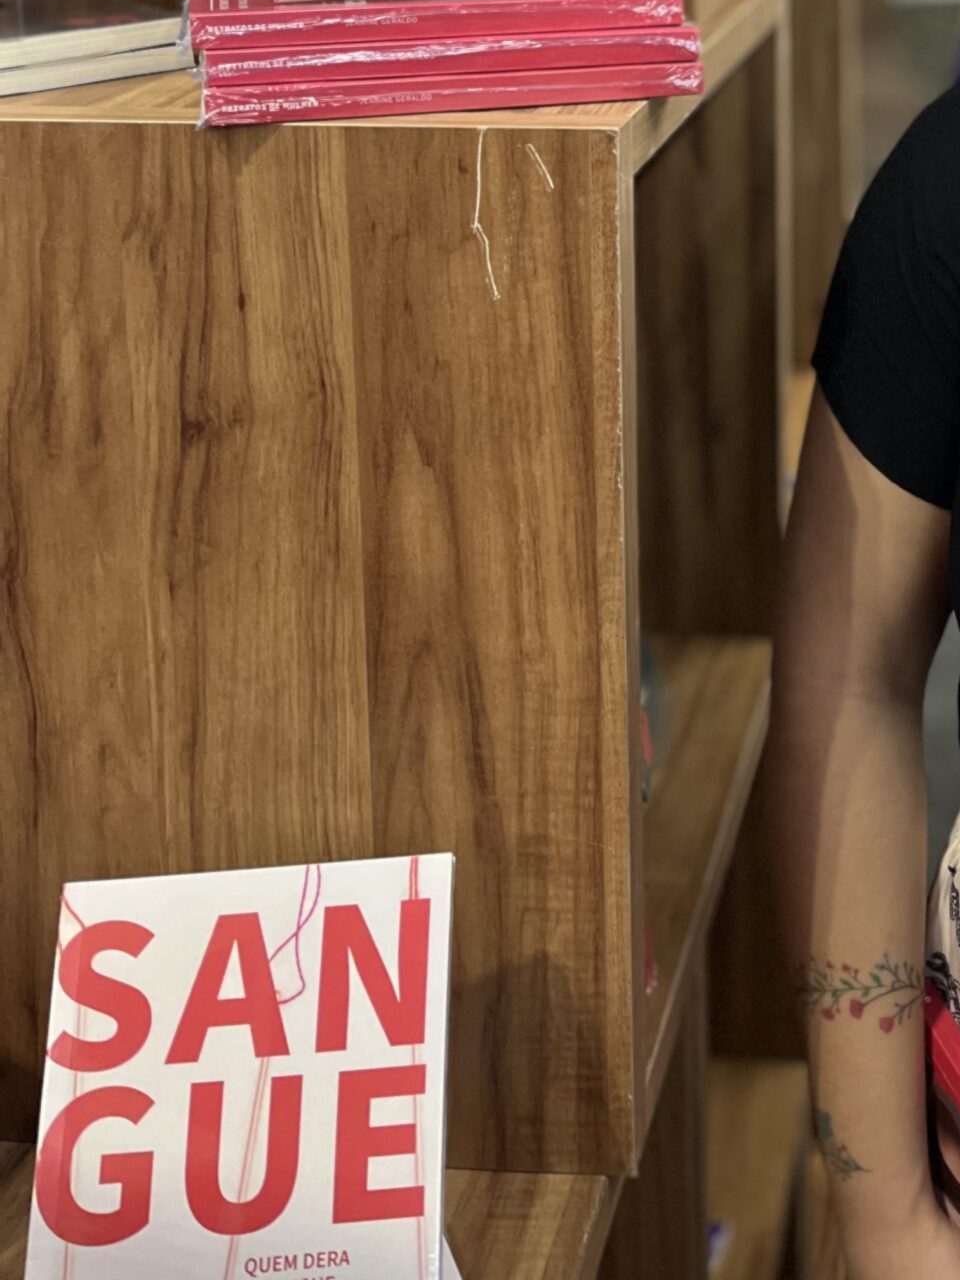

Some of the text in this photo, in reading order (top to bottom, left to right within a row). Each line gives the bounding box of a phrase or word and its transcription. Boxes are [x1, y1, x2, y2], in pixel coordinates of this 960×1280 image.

[45, 898, 431, 1073] SAN
[35, 1063, 427, 1248] GUE
[244, 1250, 350, 1278] QUEM DERA
